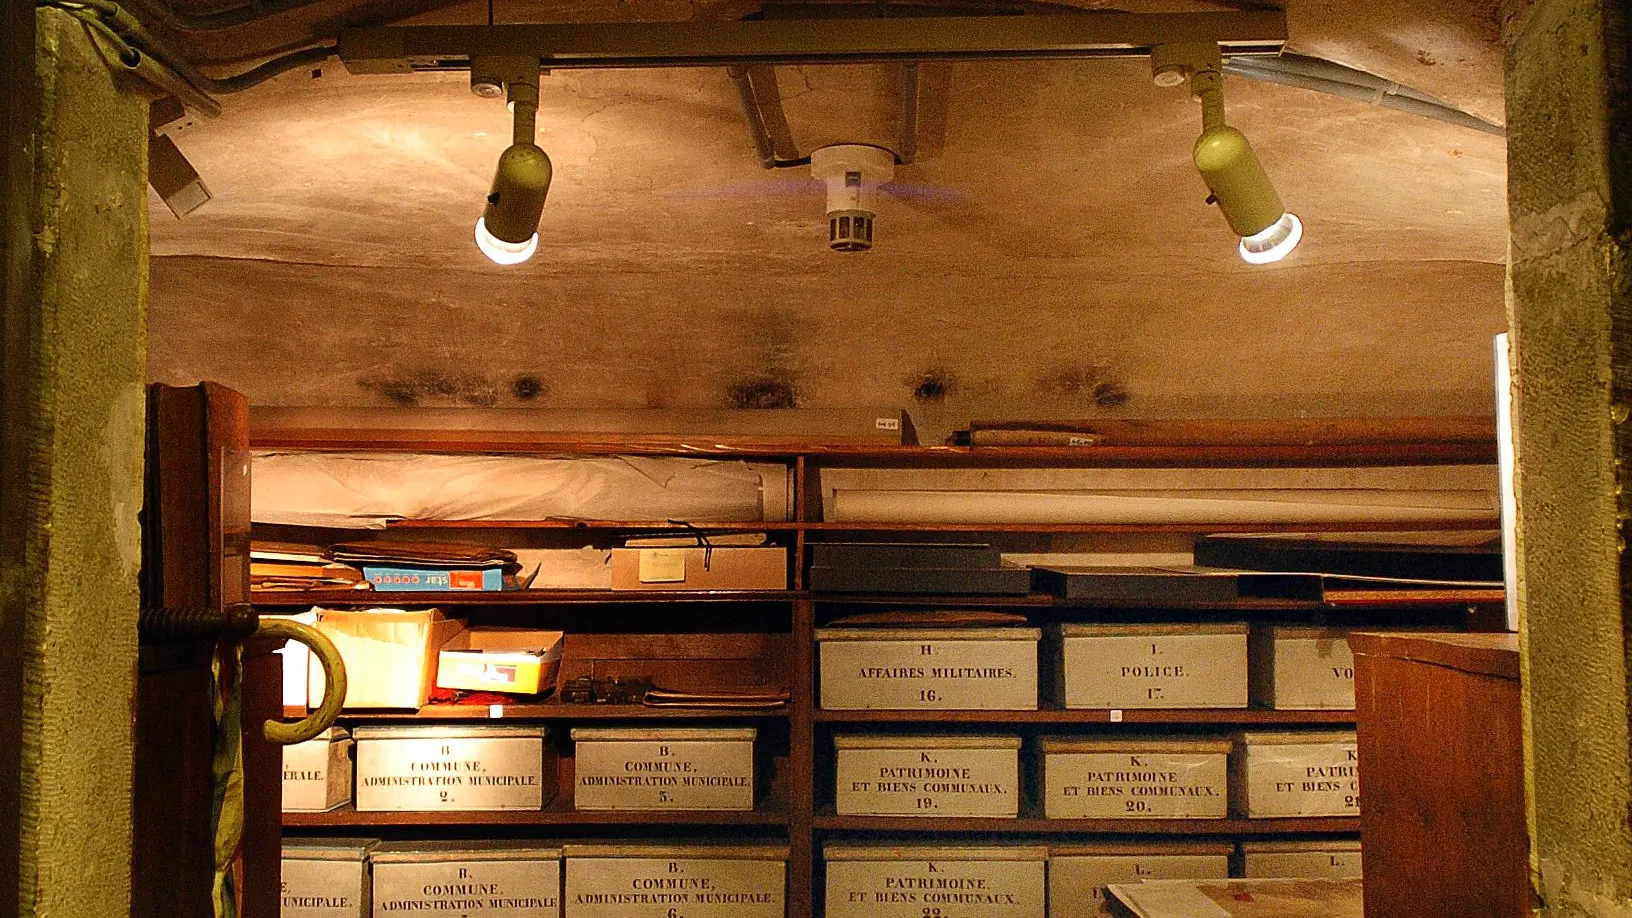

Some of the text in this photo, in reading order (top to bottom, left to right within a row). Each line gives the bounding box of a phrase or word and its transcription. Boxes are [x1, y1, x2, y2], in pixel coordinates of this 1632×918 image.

[858, 667, 1016, 679] AFFAIRES MILITAIRES.
[1121, 666, 1190, 677] POLICE.
[920, 690, 942, 701] 16.
[659, 746, 675, 757] B.
[921, 752, 938, 763] K.
[1130, 756, 1148, 766] K.
[411, 761, 486, 773] COMMUNE,
[880, 767, 970, 779] PATRIMOINE
[1088, 772, 1177, 783] PATRIMOINE
[362, 776, 462, 787] ADMINISTRATION
[580, 776, 678, 787] ADMINISTRATION
[1276, 782, 1294, 793] ET
[1303, 781, 1340, 792] BIENS
[852, 782, 1008, 795] ET BIENS COMMUNAUX.
[1063, 786, 1220, 797] ET BIENS COMMUNAUX.
[440, 790, 455, 802] 2.
[916, 798, 938, 809] 19.
[1125, 801, 1152, 812] 20.
[1330, 855, 1345, 866] L.
[668, 862, 684, 874] B.
[929, 862, 944, 873] K.
[1135, 864, 1151, 875] L.
[575, 893, 775, 904] ADMINISTRATION MUNICIPALE.
[850, 892, 867, 902] ET
[876, 892, 916, 903] BIENS
[379, 899, 483, 911] ADMINISTRATION
